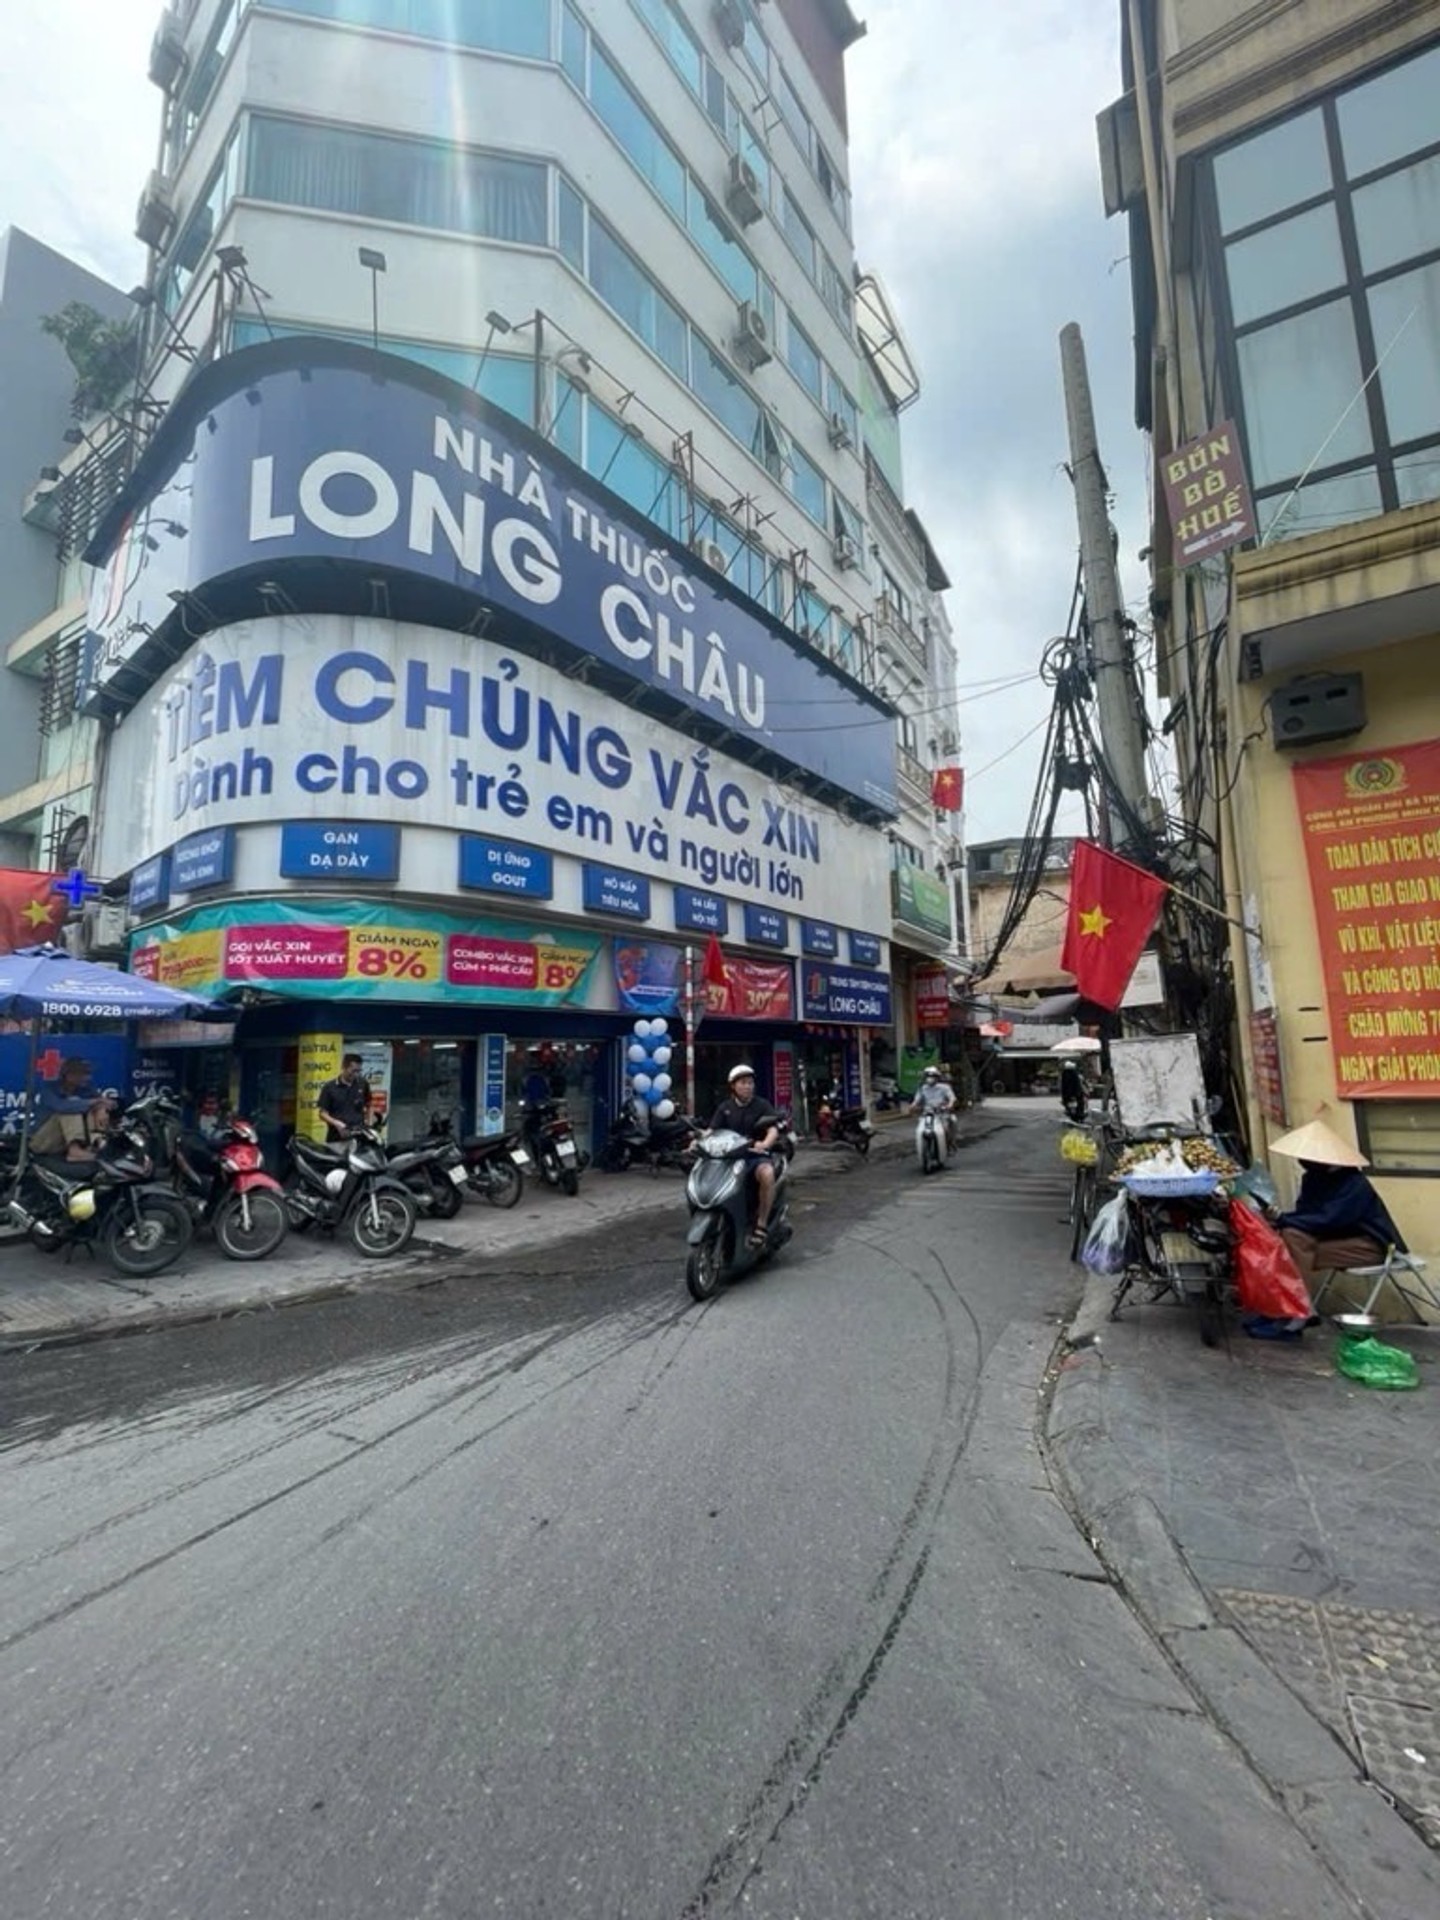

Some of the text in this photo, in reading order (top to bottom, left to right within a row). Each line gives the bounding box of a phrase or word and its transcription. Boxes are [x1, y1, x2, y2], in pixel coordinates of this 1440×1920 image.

[1168, 435, 1230, 485] BÚN
[1183, 469, 1226, 507] BÒ
[434, 415, 697, 613] NHÀ THUỐC
[1176, 484, 1243, 541] HUẾ
[249, 450, 766, 728] LONG CHÂU
[167, 651, 821, 864] TIÊM CHỦNG VẮC XIN
[174, 745, 805, 901] Dành cho trẻ em và người lớn
[323, 831, 359, 845] GAN
[310, 852, 370, 868] DẠ DÀY
[487, 850, 532, 868] DỊ ỨNG
[1325, 840, 1360, 871] TOÀN
[1361, 836, 1390, 866] DÂN
[1390, 832, 1422, 862] TÍCH
[492, 871, 527, 887] GOUT
[1332, 884, 1370, 912] THAM
[1371, 881, 1394, 907] GIA
[1395, 878, 1428, 904] GIAO
[255, 938, 283, 951] VẮC
[285, 940, 311, 951] XIN
[356, 932, 440, 949] GIẢM NGAY
[1338, 923, 1357, 953] VŨ
[1385, 918, 1411, 953] VẬT
[255, 952, 292, 965] XUẤT
[295, 952, 346, 965] HUYẾT
[356, 947, 428, 980] 8%
[453, 949, 495, 961] COMBO
[453, 961, 480, 973] CÚM
[1342, 964, 1363, 995] VÀ
[1363, 963, 1401, 994] CÔNG
[1401, 965, 1421, 997] CỤ
[42, 1002, 81, 1016] 1800
[84, 1003, 122, 1017] 6928
[828, 995, 856, 1014] LONG
[857, 996, 882, 1016] CHÂU
[1348, 1008, 1384, 1039] CHÀO
[1385, 1006, 1428, 1037] MỪNG
[1340, 1051, 1374, 1082] NGÀY
[1377, 1047, 1406, 1082] GIẢI
